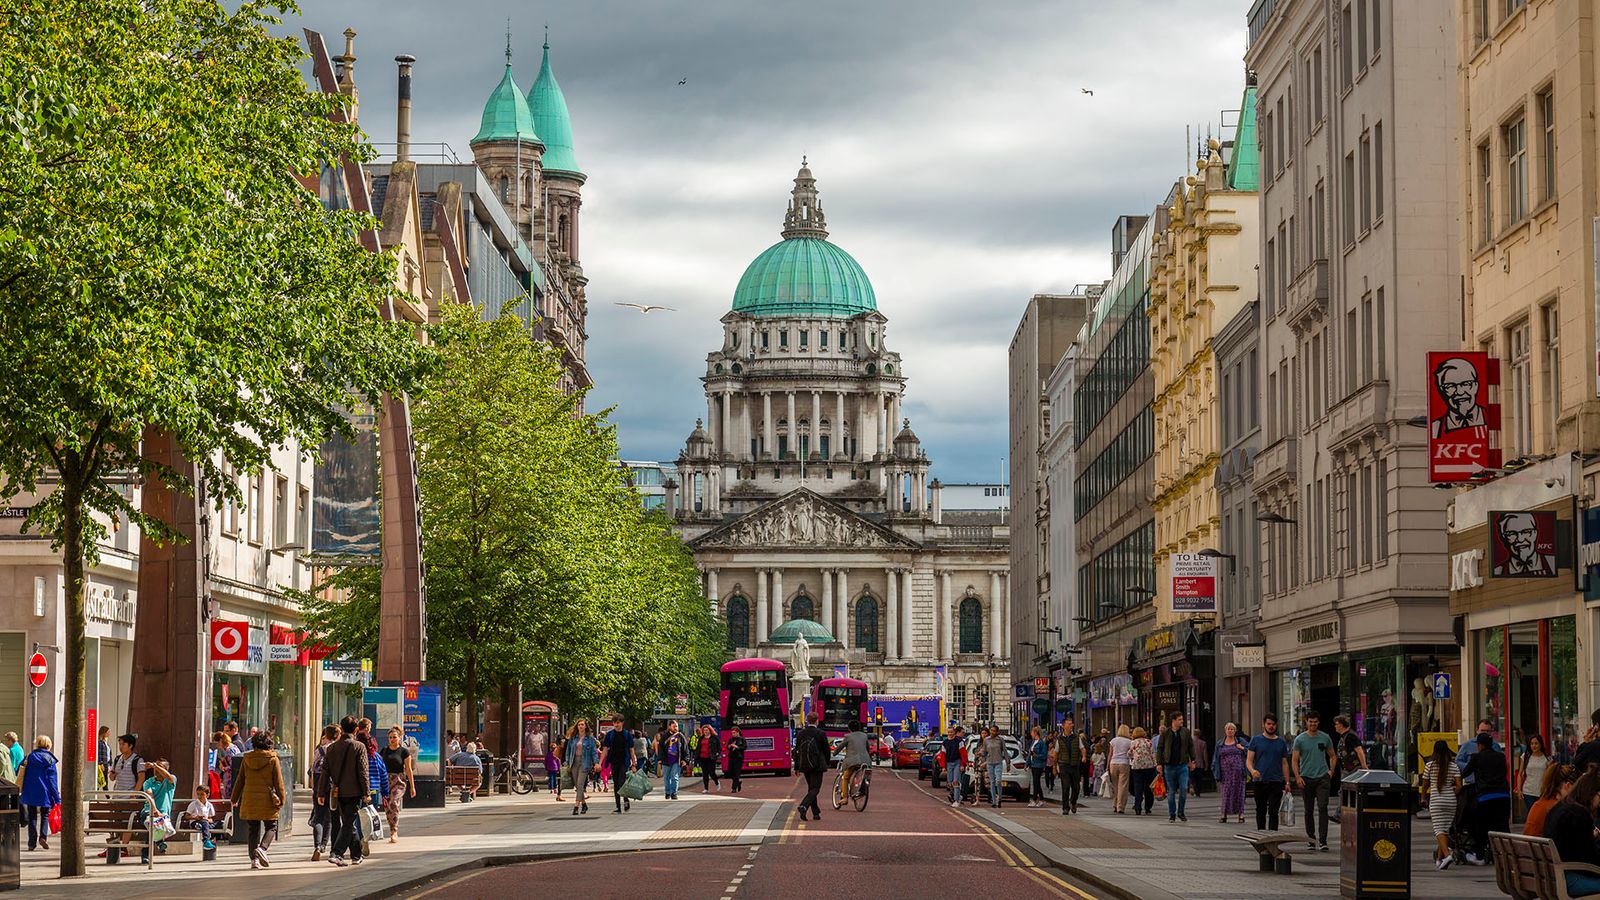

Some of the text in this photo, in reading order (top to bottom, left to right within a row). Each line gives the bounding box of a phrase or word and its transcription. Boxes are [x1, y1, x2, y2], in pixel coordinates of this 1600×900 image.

[1434, 443, 1481, 459] KFC
[1451, 549, 1484, 591] KFC
[1370, 821, 1401, 829] LITTER
